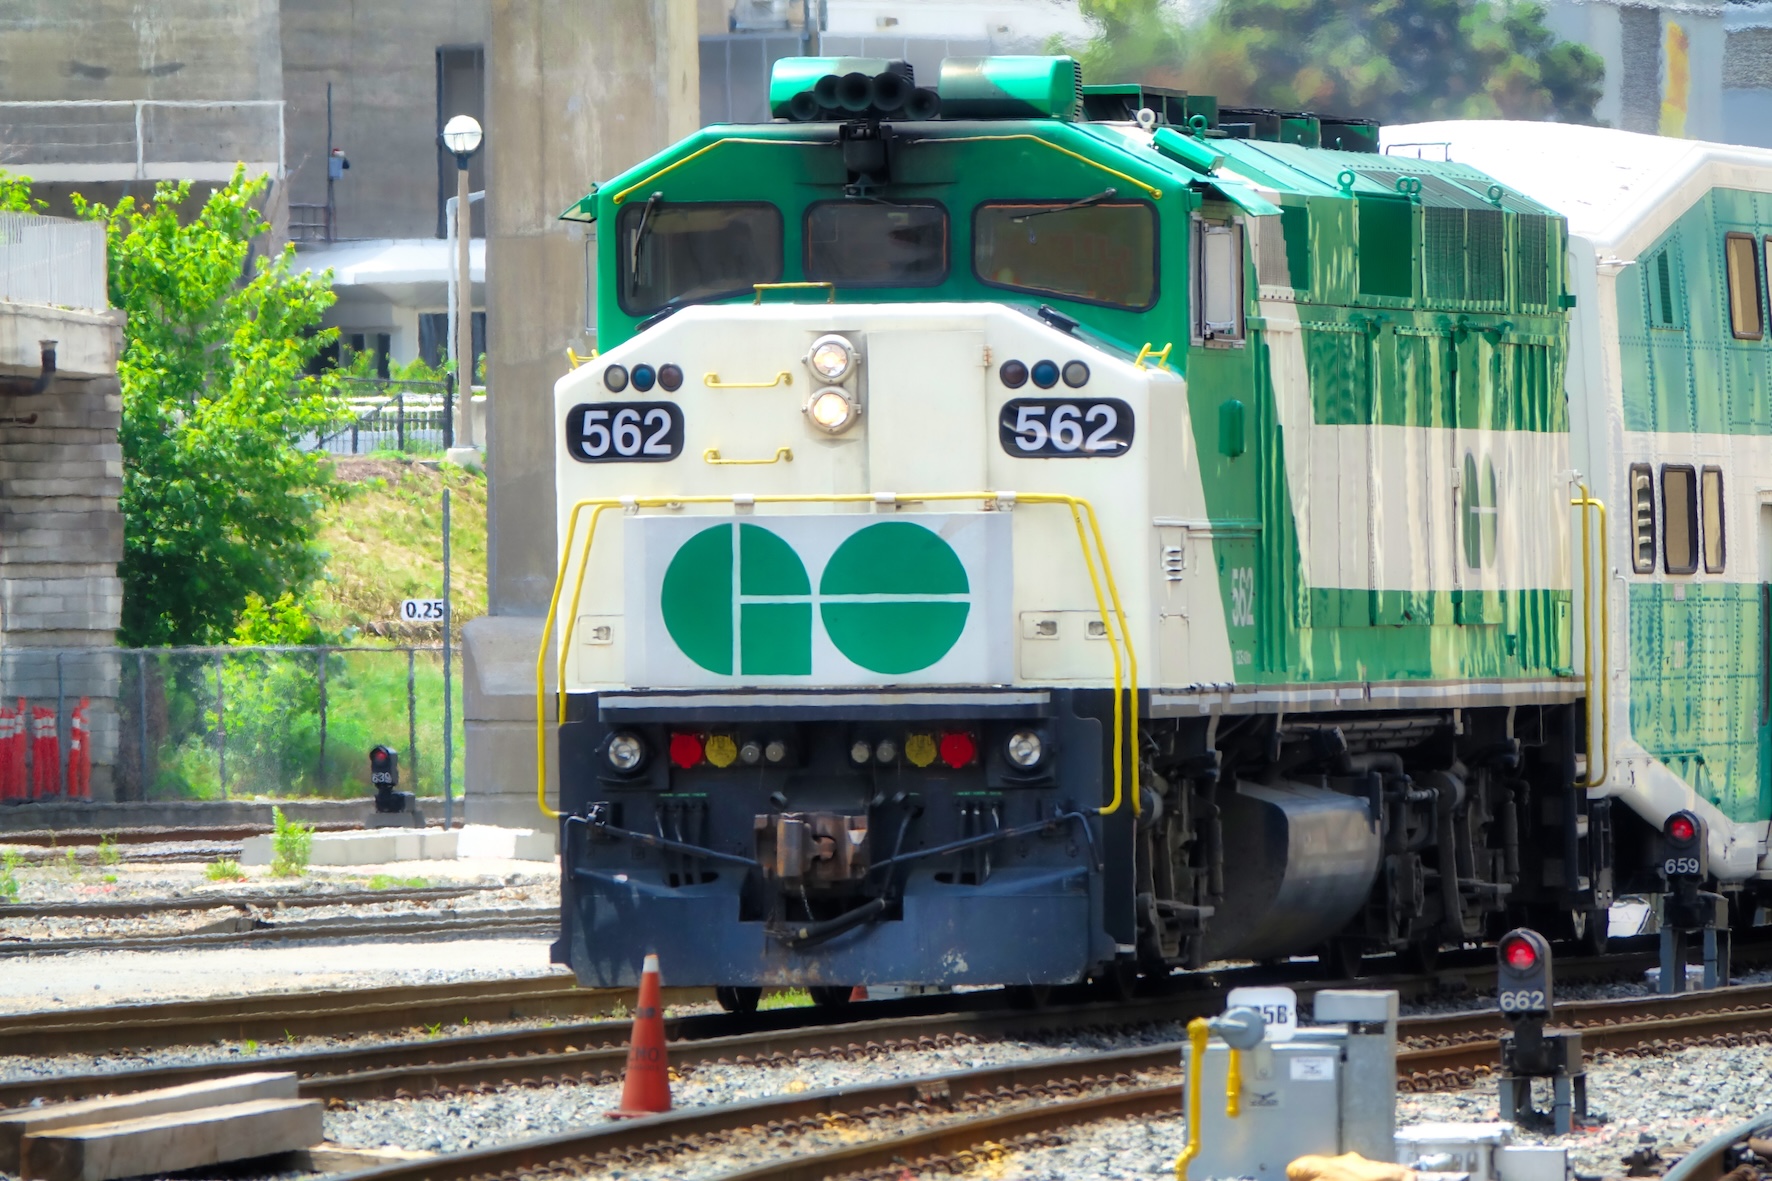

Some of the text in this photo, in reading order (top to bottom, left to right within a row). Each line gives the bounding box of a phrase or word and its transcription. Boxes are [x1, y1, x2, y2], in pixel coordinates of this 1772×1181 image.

[581, 408, 672, 457] 562
[1014, 404, 1118, 451] 562
[661, 521, 971, 676] GO
[1231, 566, 1255, 627] 562
[405, 601, 443, 618] 0.25
[372, 772, 392, 783] 639
[1664, 857, 1700, 875] 659
[1500, 990, 1545, 1012] 662
[1253, 1005, 1288, 1025] 5B
